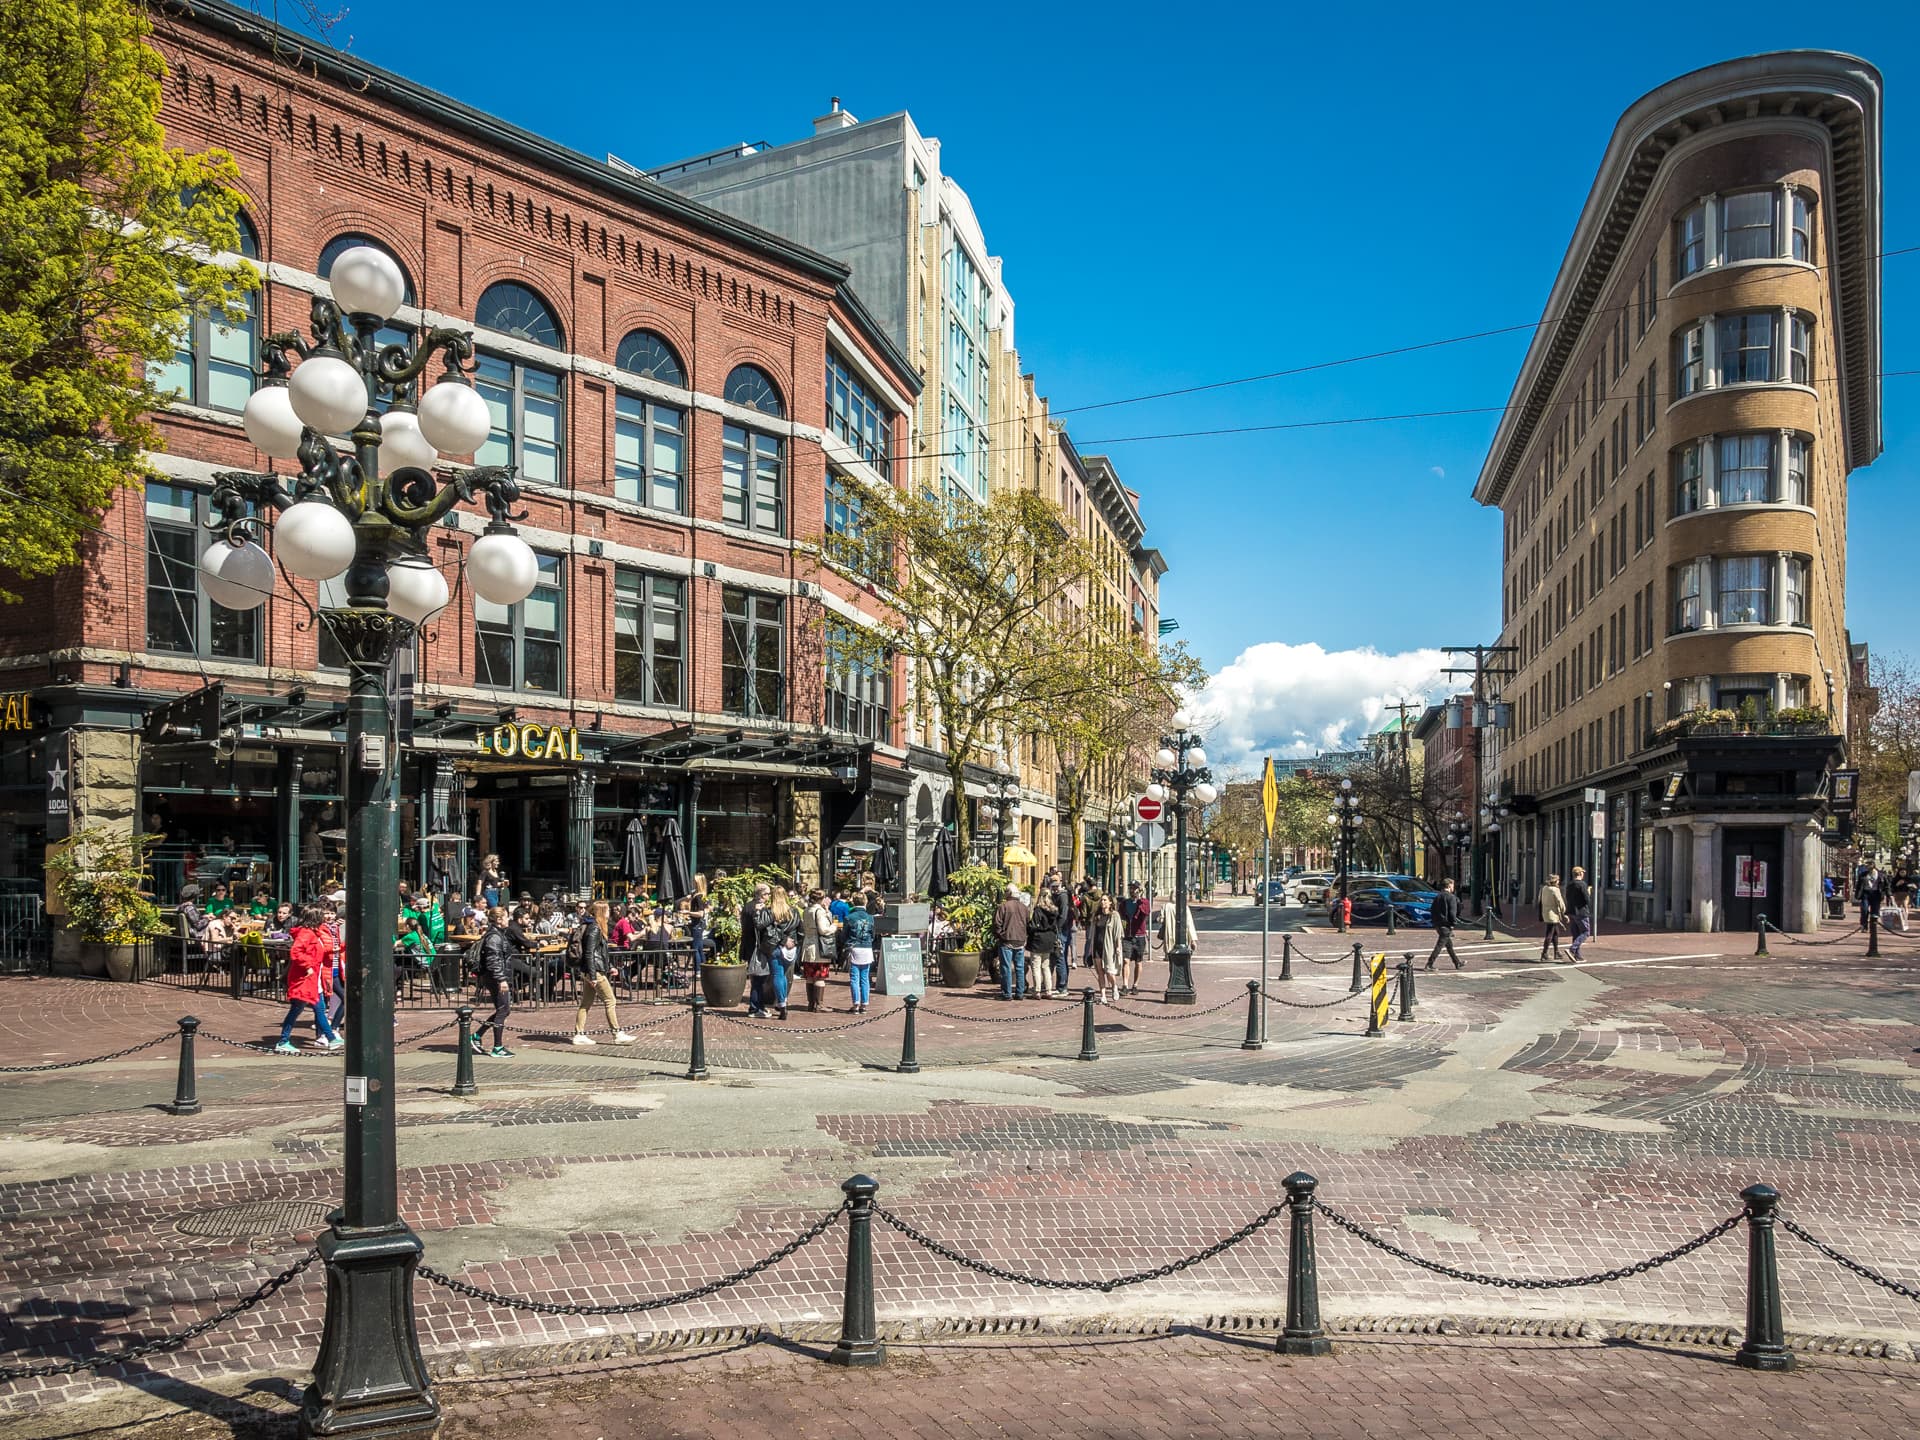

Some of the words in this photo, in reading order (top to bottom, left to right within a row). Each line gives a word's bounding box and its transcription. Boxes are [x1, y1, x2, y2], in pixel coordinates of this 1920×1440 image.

[0, 694, 33, 730] AL
[477, 722, 584, 761] LOCAL
[1839, 782, 1847, 791] K
[48, 799, 69, 810] LOCAL
